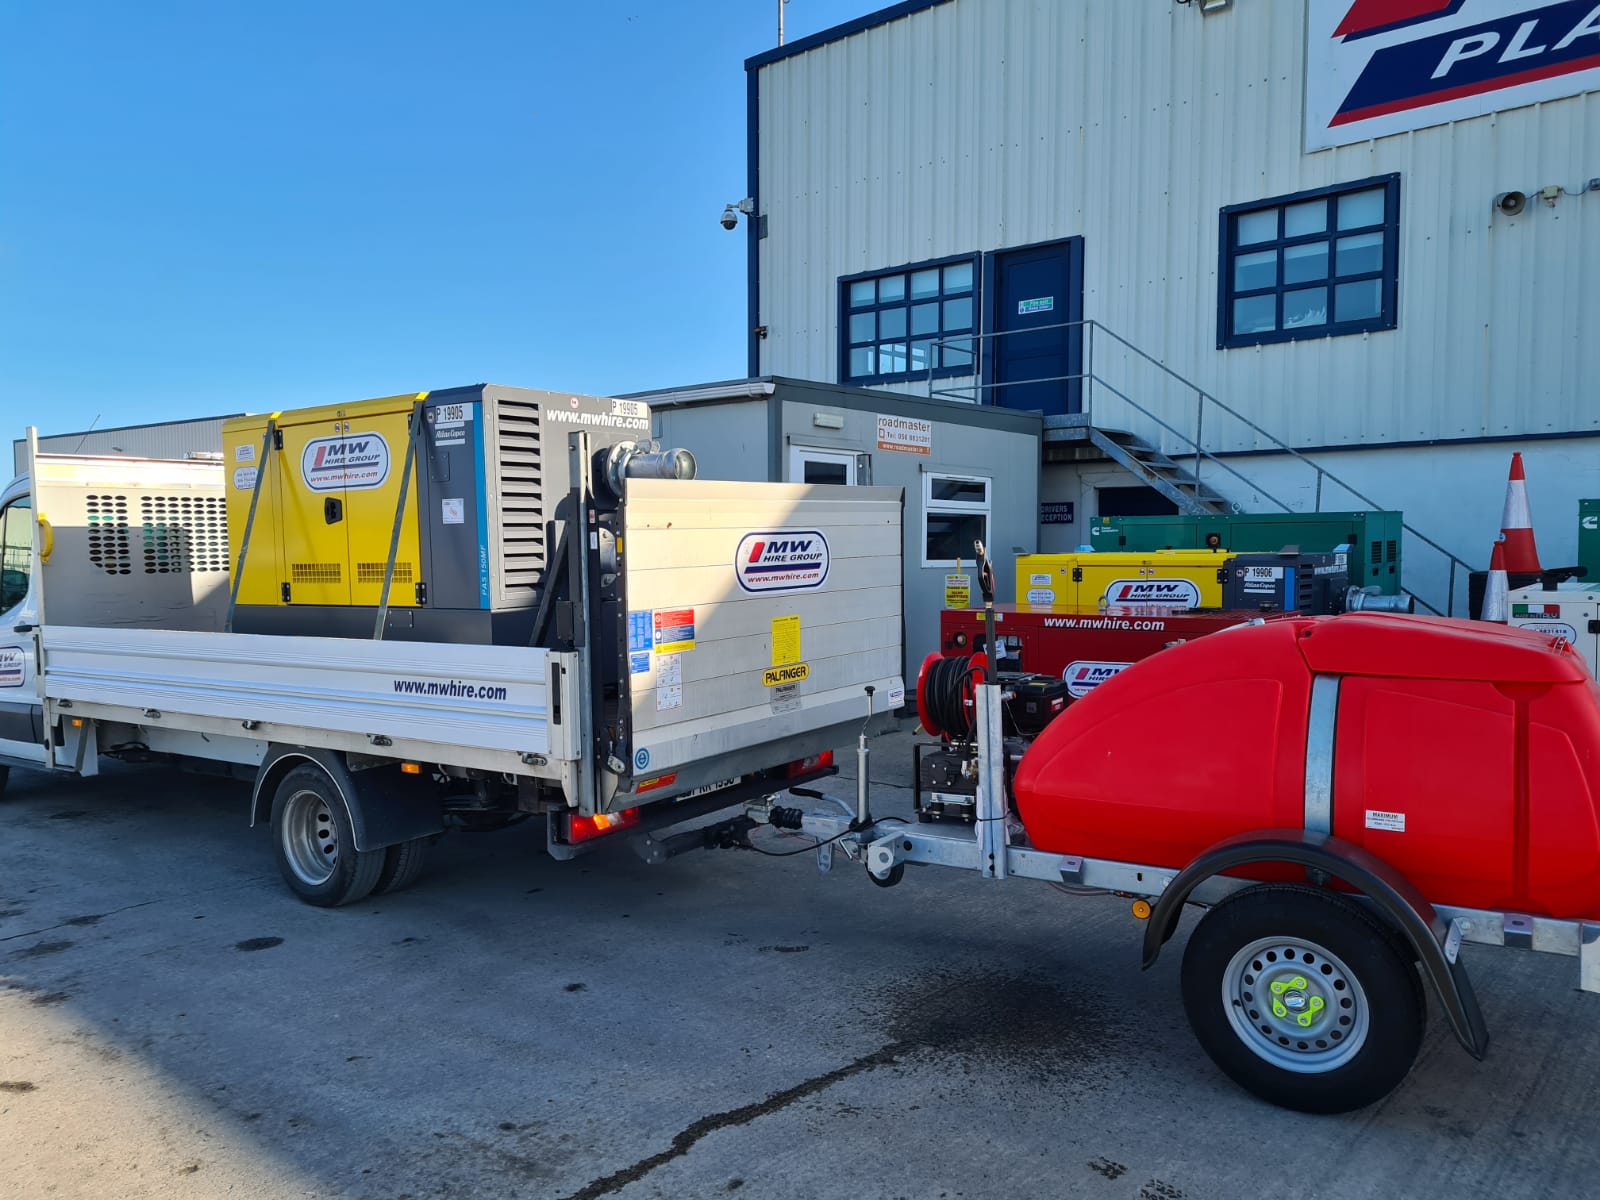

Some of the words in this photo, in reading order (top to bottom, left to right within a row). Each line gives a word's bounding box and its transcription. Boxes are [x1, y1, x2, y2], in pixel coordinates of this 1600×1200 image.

[436, 407, 441, 421] P
[444, 405, 464, 421] 19905
[612, 401, 617, 411] P
[619, 402, 638, 416] 19905
[546, 409, 649, 430] www.mwhire.com
[878, 417, 930, 433] roadmaster
[327, 441, 370, 456] MW
[324, 457, 345, 465] HIRE
[348, 454, 380, 463] GROUP
[310, 471, 378, 482] www.mwhire.com
[1041, 505, 1068, 513] DRIVERS
[1041, 513, 1072, 521] ECEPTION
[767, 540, 812, 553] MW
[763, 554, 787, 563] HIRE
[789, 553, 823, 561] GROUP
[747, 572, 820, 583] www.mwhire.com
[1244, 568, 1250, 577] P
[1253, 567, 1273, 578] 19906
[1134, 584, 1178, 592] MW
[1044, 617, 1165, 631] www.mwhire.com
[765, 666, 807, 684] PALFINGER
[394, 679, 507, 701] www.mwhire.com
